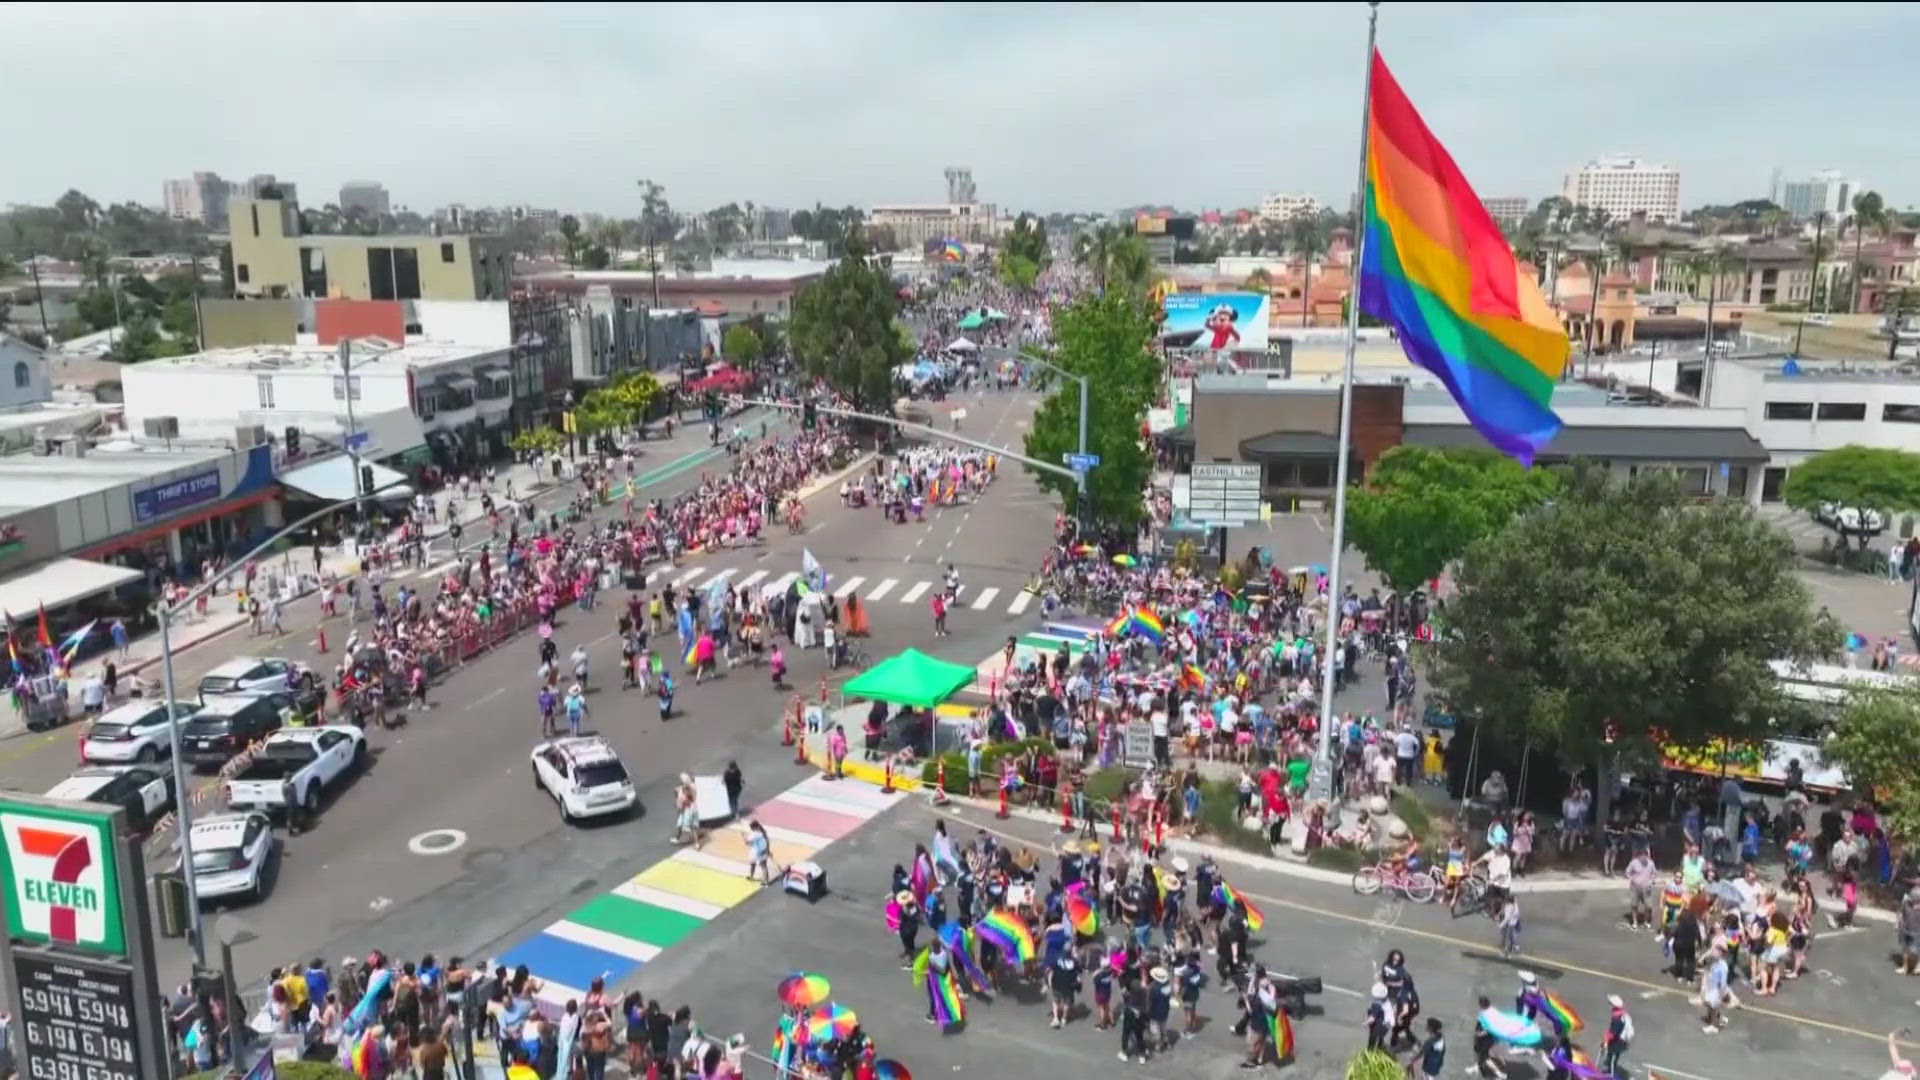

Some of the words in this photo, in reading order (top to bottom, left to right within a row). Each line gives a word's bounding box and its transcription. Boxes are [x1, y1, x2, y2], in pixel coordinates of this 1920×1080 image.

[157, 482, 188, 502] THRIFT
[190, 473, 218, 492] STORE
[18, 827, 91, 944] 7
